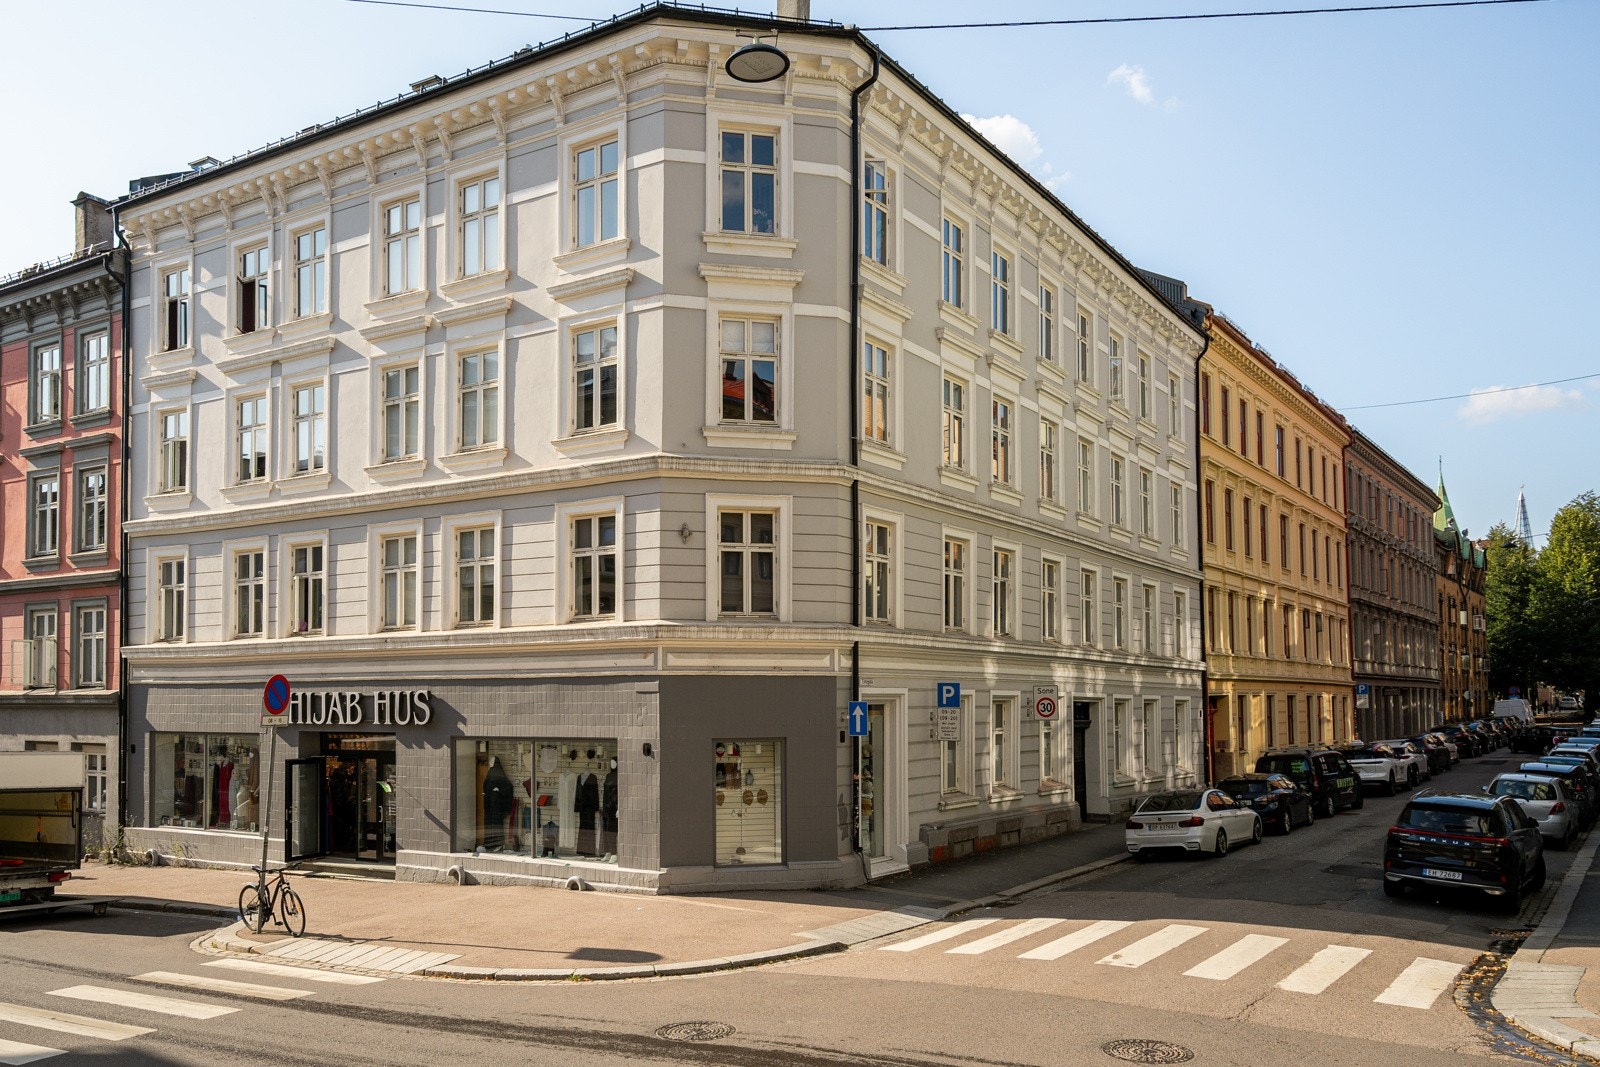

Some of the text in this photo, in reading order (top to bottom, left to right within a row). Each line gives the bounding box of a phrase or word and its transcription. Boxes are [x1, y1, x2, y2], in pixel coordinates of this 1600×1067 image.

[942, 685, 955, 705] P
[1037, 687, 1054, 695] Sone
[288, 690, 431, 726] HIJAB HUS
[1040, 702, 1053, 712] 30
